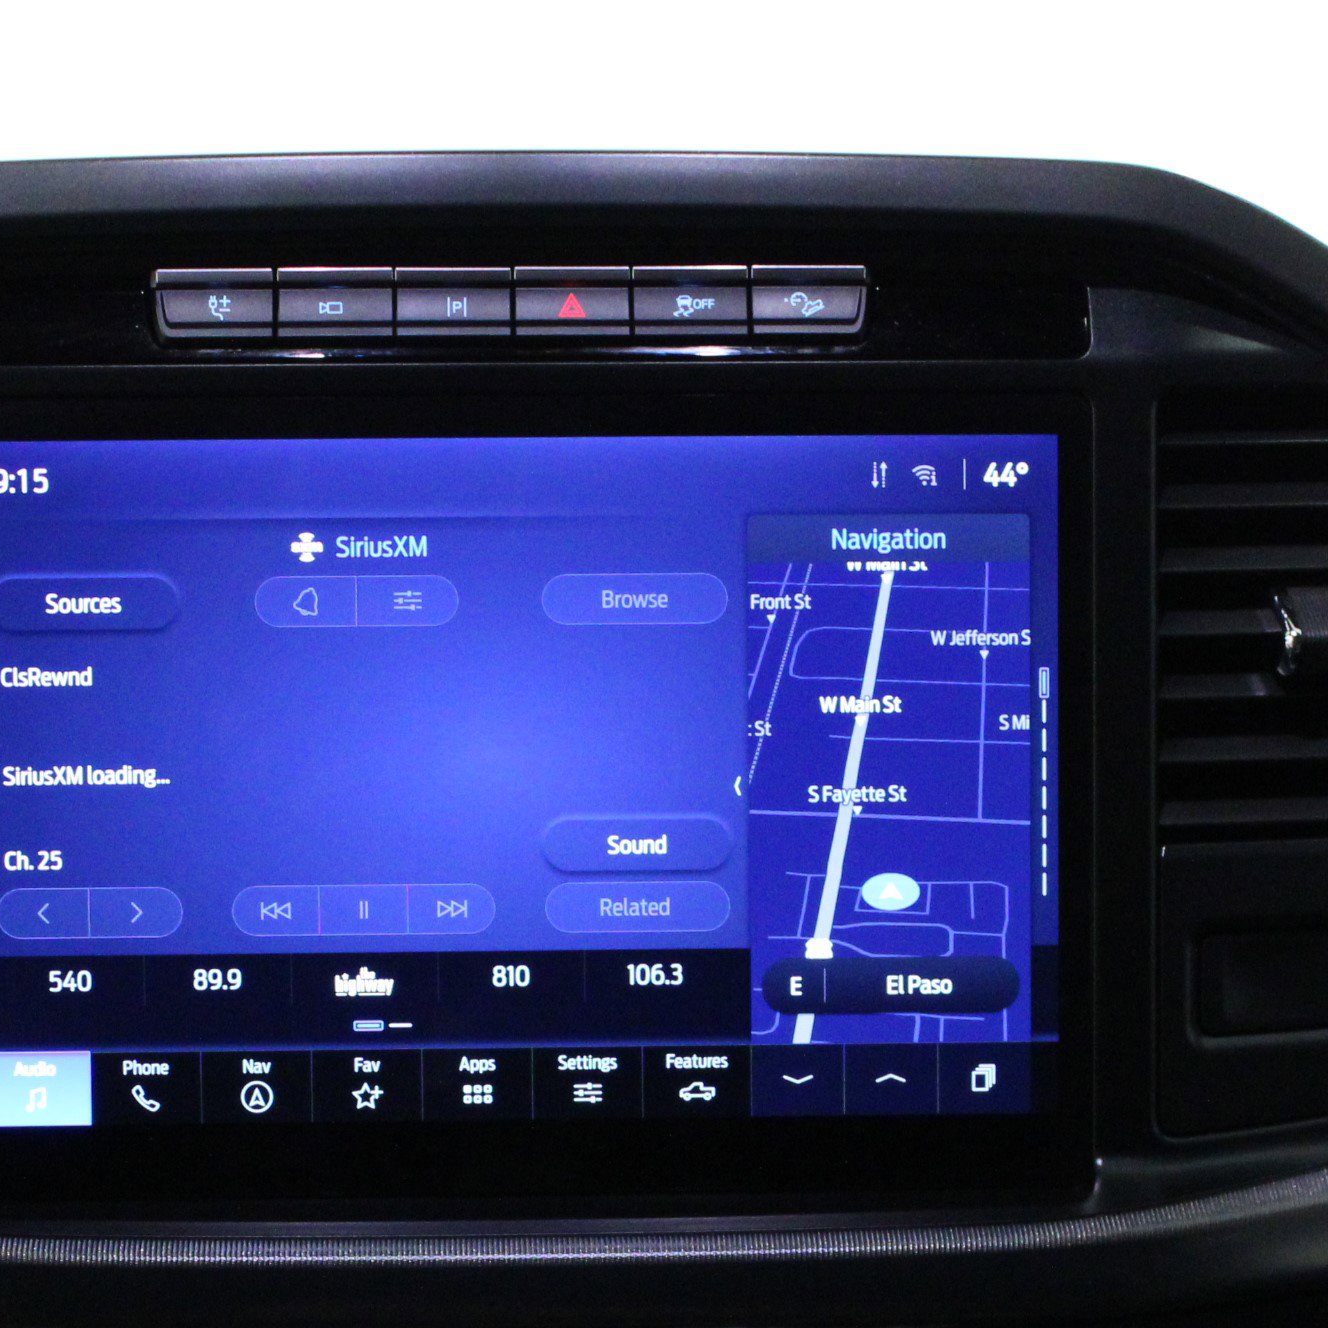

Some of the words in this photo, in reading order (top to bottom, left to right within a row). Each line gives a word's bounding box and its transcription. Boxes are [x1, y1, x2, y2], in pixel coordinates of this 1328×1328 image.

[693, 299, 715, 310] OFF
[335, 535, 428, 558] SiriusXM
[831, 528, 947, 553] Navigation
[45, 593, 122, 615] Sources
[601, 590, 669, 609] Browse
[750, 594, 792, 610] Front
[794, 593, 812, 610] St
[930, 631, 947, 646] W
[950, 629, 1019, 646] Jefferson
[819, 696, 838, 713] W
[840, 696, 881, 713] Main
[882, 695, 903, 713] St
[999, 715, 1010, 731] S
[2, 766, 83, 786] SiriusXM
[86, 765, 171, 789] loading...
[808, 786, 820, 803] S
[822, 785, 886, 806] Fayette
[888, 785, 907, 803] St
[607, 834, 668, 855] Sound
[4, 852, 35, 871] Ch.
[37, 851, 63, 871] 25
[600, 898, 671, 917] Related
[48, 970, 93, 993] 540
[193, 969, 242, 991] 89.9
[492, 966, 530, 988] 810
[626, 964, 683, 986] 106.3
[790, 976, 803, 996] E
[886, 975, 905, 995] El
[907, 974, 953, 995] Paso
[123, 1060, 169, 1077] Phone
[242, 1059, 271, 1075] Nav
[354, 1058, 381, 1074] Fav
[459, 1056, 496, 1076] Apps
[557, 1053, 618, 1073] Settings
[665, 1053, 729, 1070] Features
